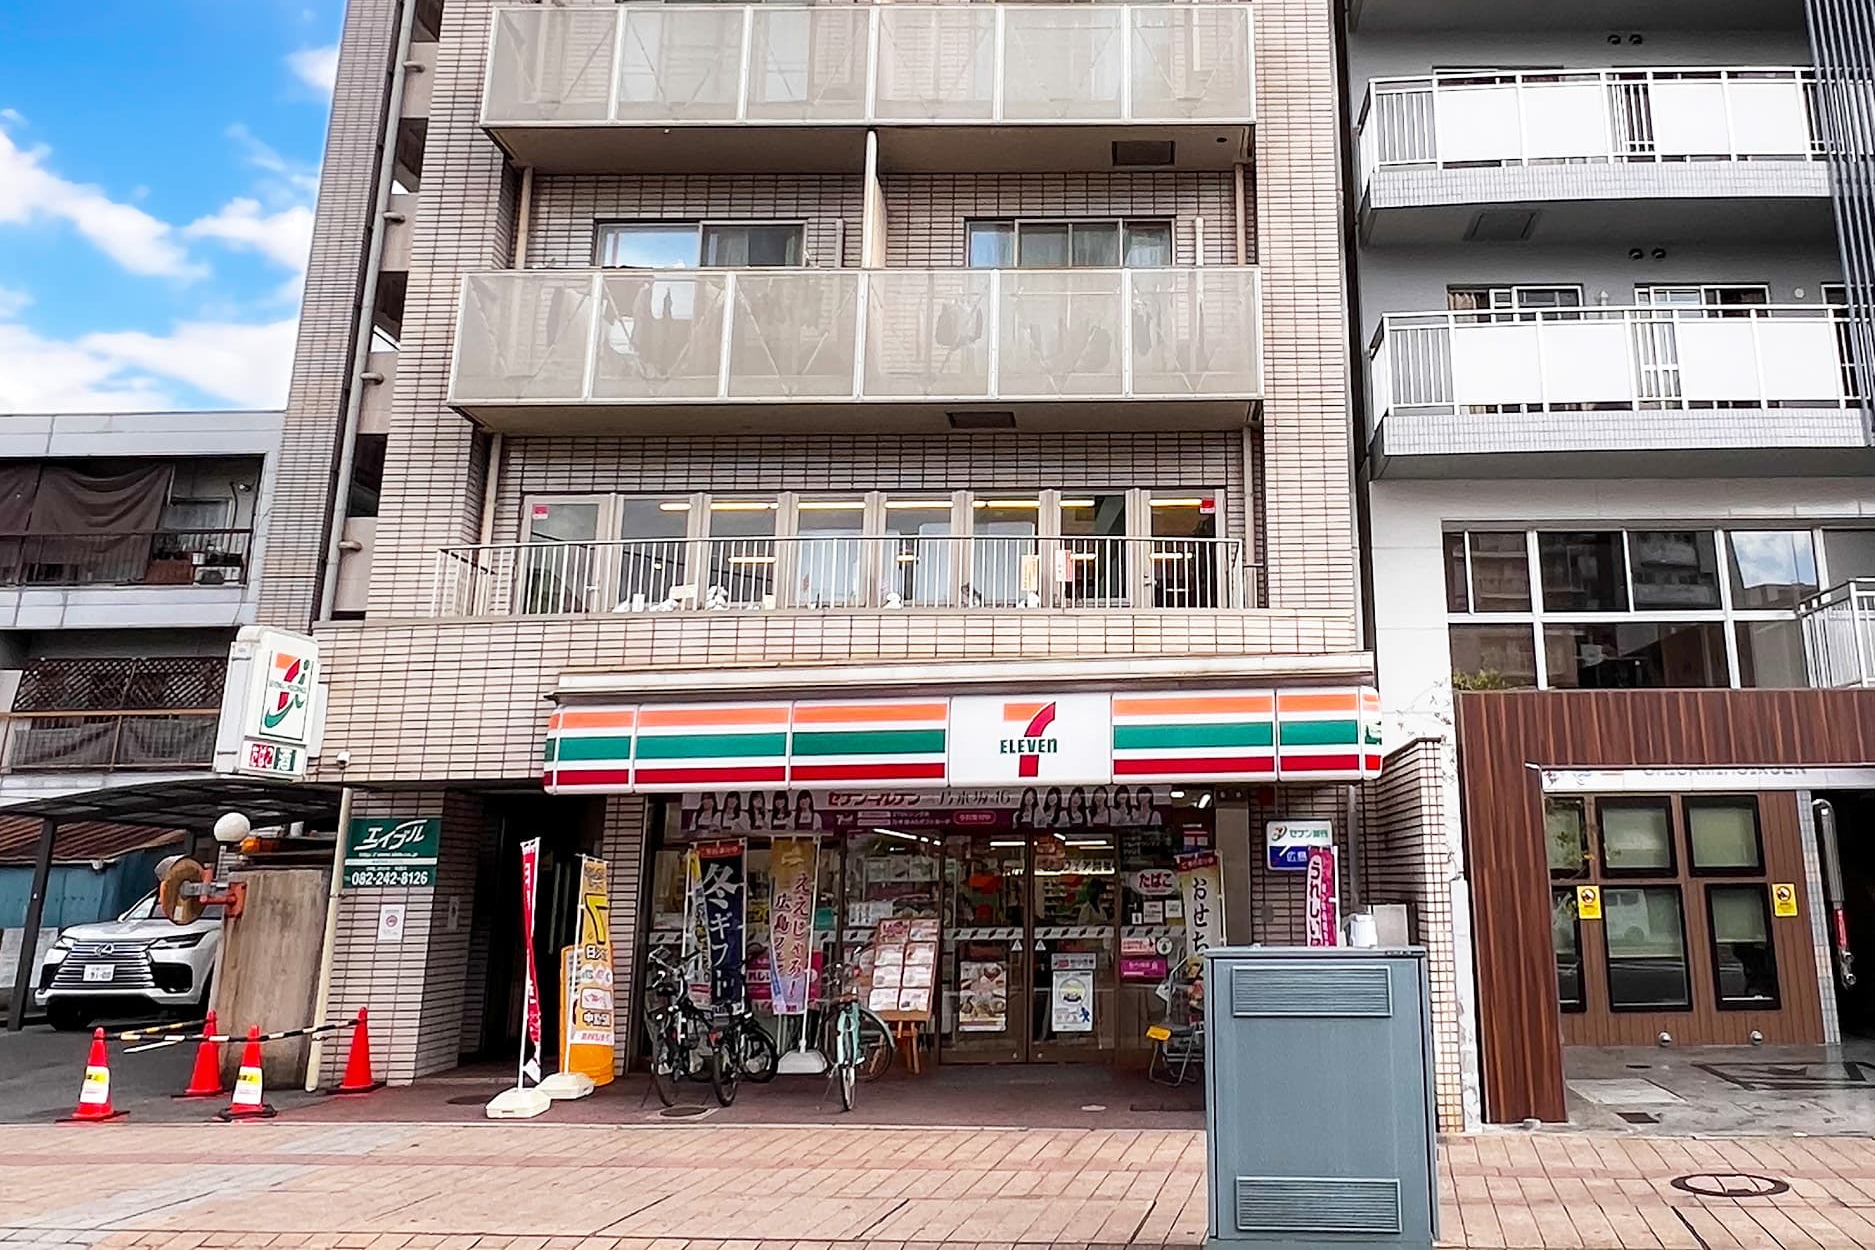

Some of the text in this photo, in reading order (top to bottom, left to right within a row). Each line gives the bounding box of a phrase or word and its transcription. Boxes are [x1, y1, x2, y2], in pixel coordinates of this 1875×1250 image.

[353, 819, 428, 851] エイブル
[351, 871, 428, 885] 082-242-8126
[1139, 873, 1173, 888] たばこ
[1190, 877, 1211, 953] おせち
